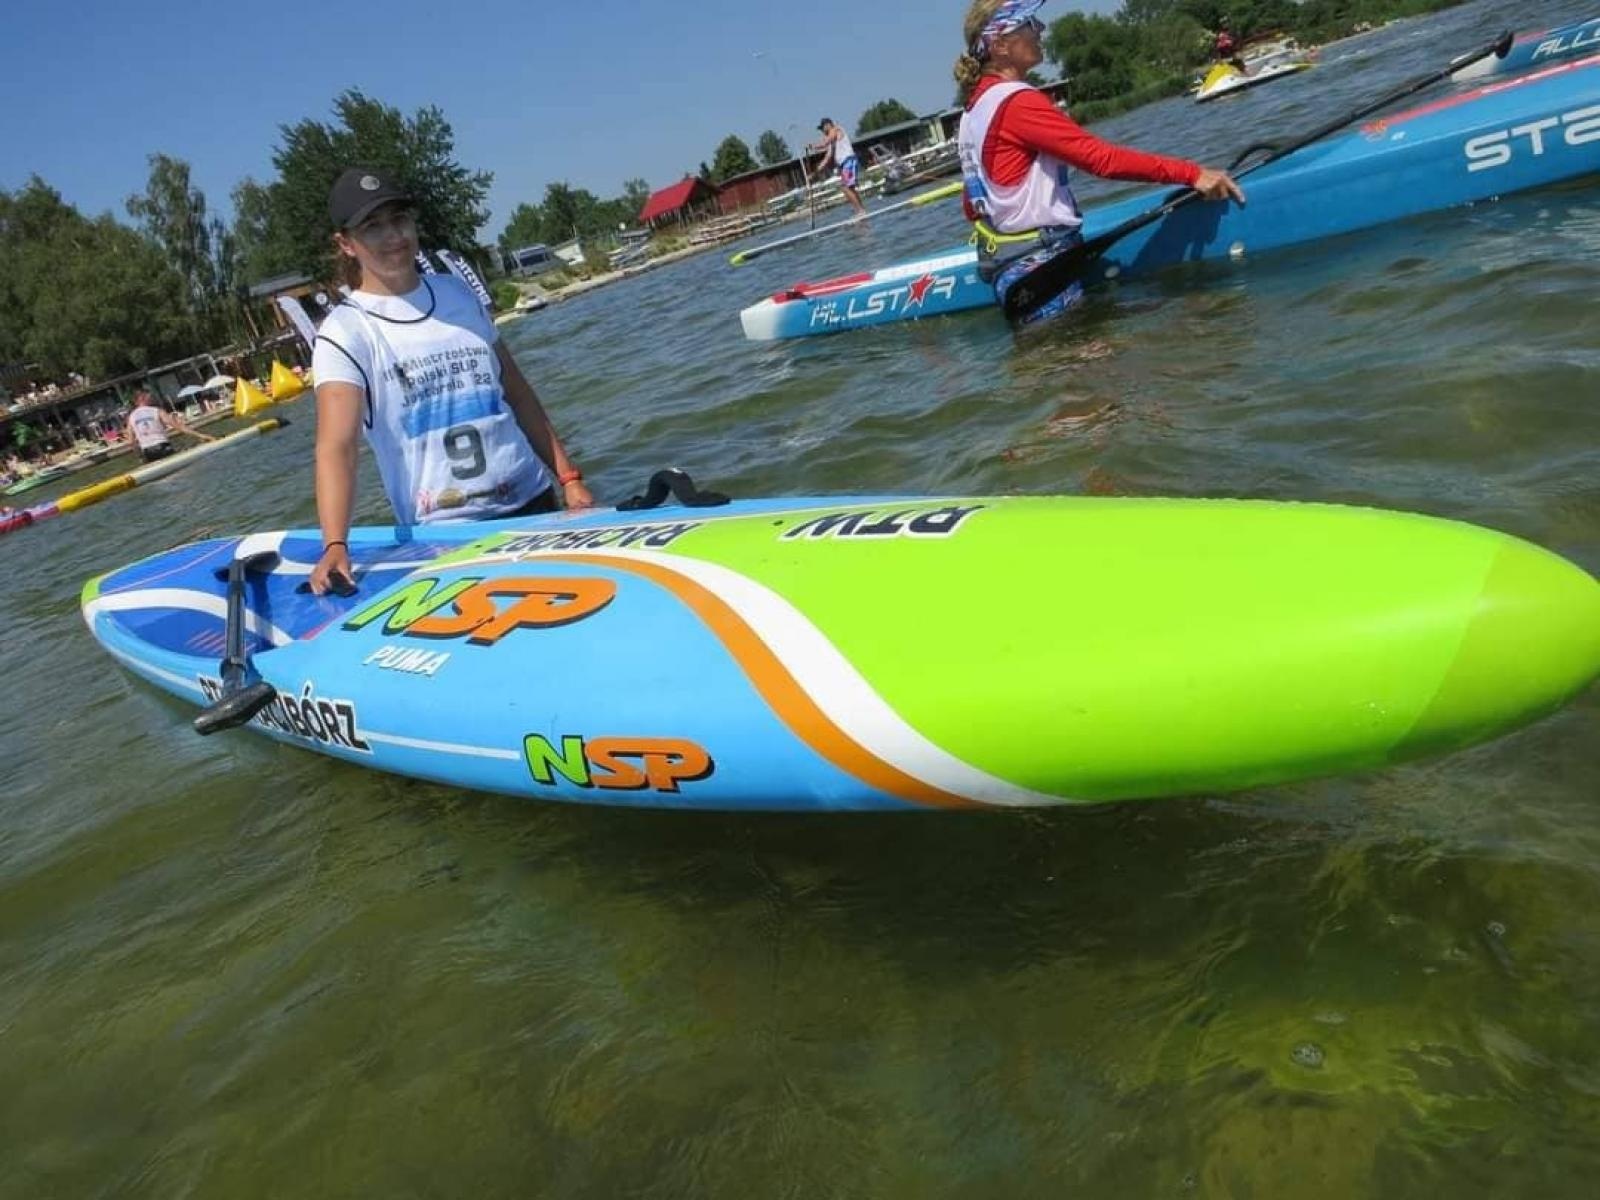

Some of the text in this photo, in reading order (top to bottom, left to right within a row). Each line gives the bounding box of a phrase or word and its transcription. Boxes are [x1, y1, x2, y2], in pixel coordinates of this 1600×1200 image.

[1531, 27, 1600, 60] ALL
[451, 359, 478, 375] SUP
[443, 424, 487, 480] 9
[784, 505, 985, 537] RTW
[341, 577, 617, 646] NSP
[362, 645, 451, 676] PUMA
[257, 685, 370, 750] ACIBÓRZ
[523, 733, 715, 793] NSP
